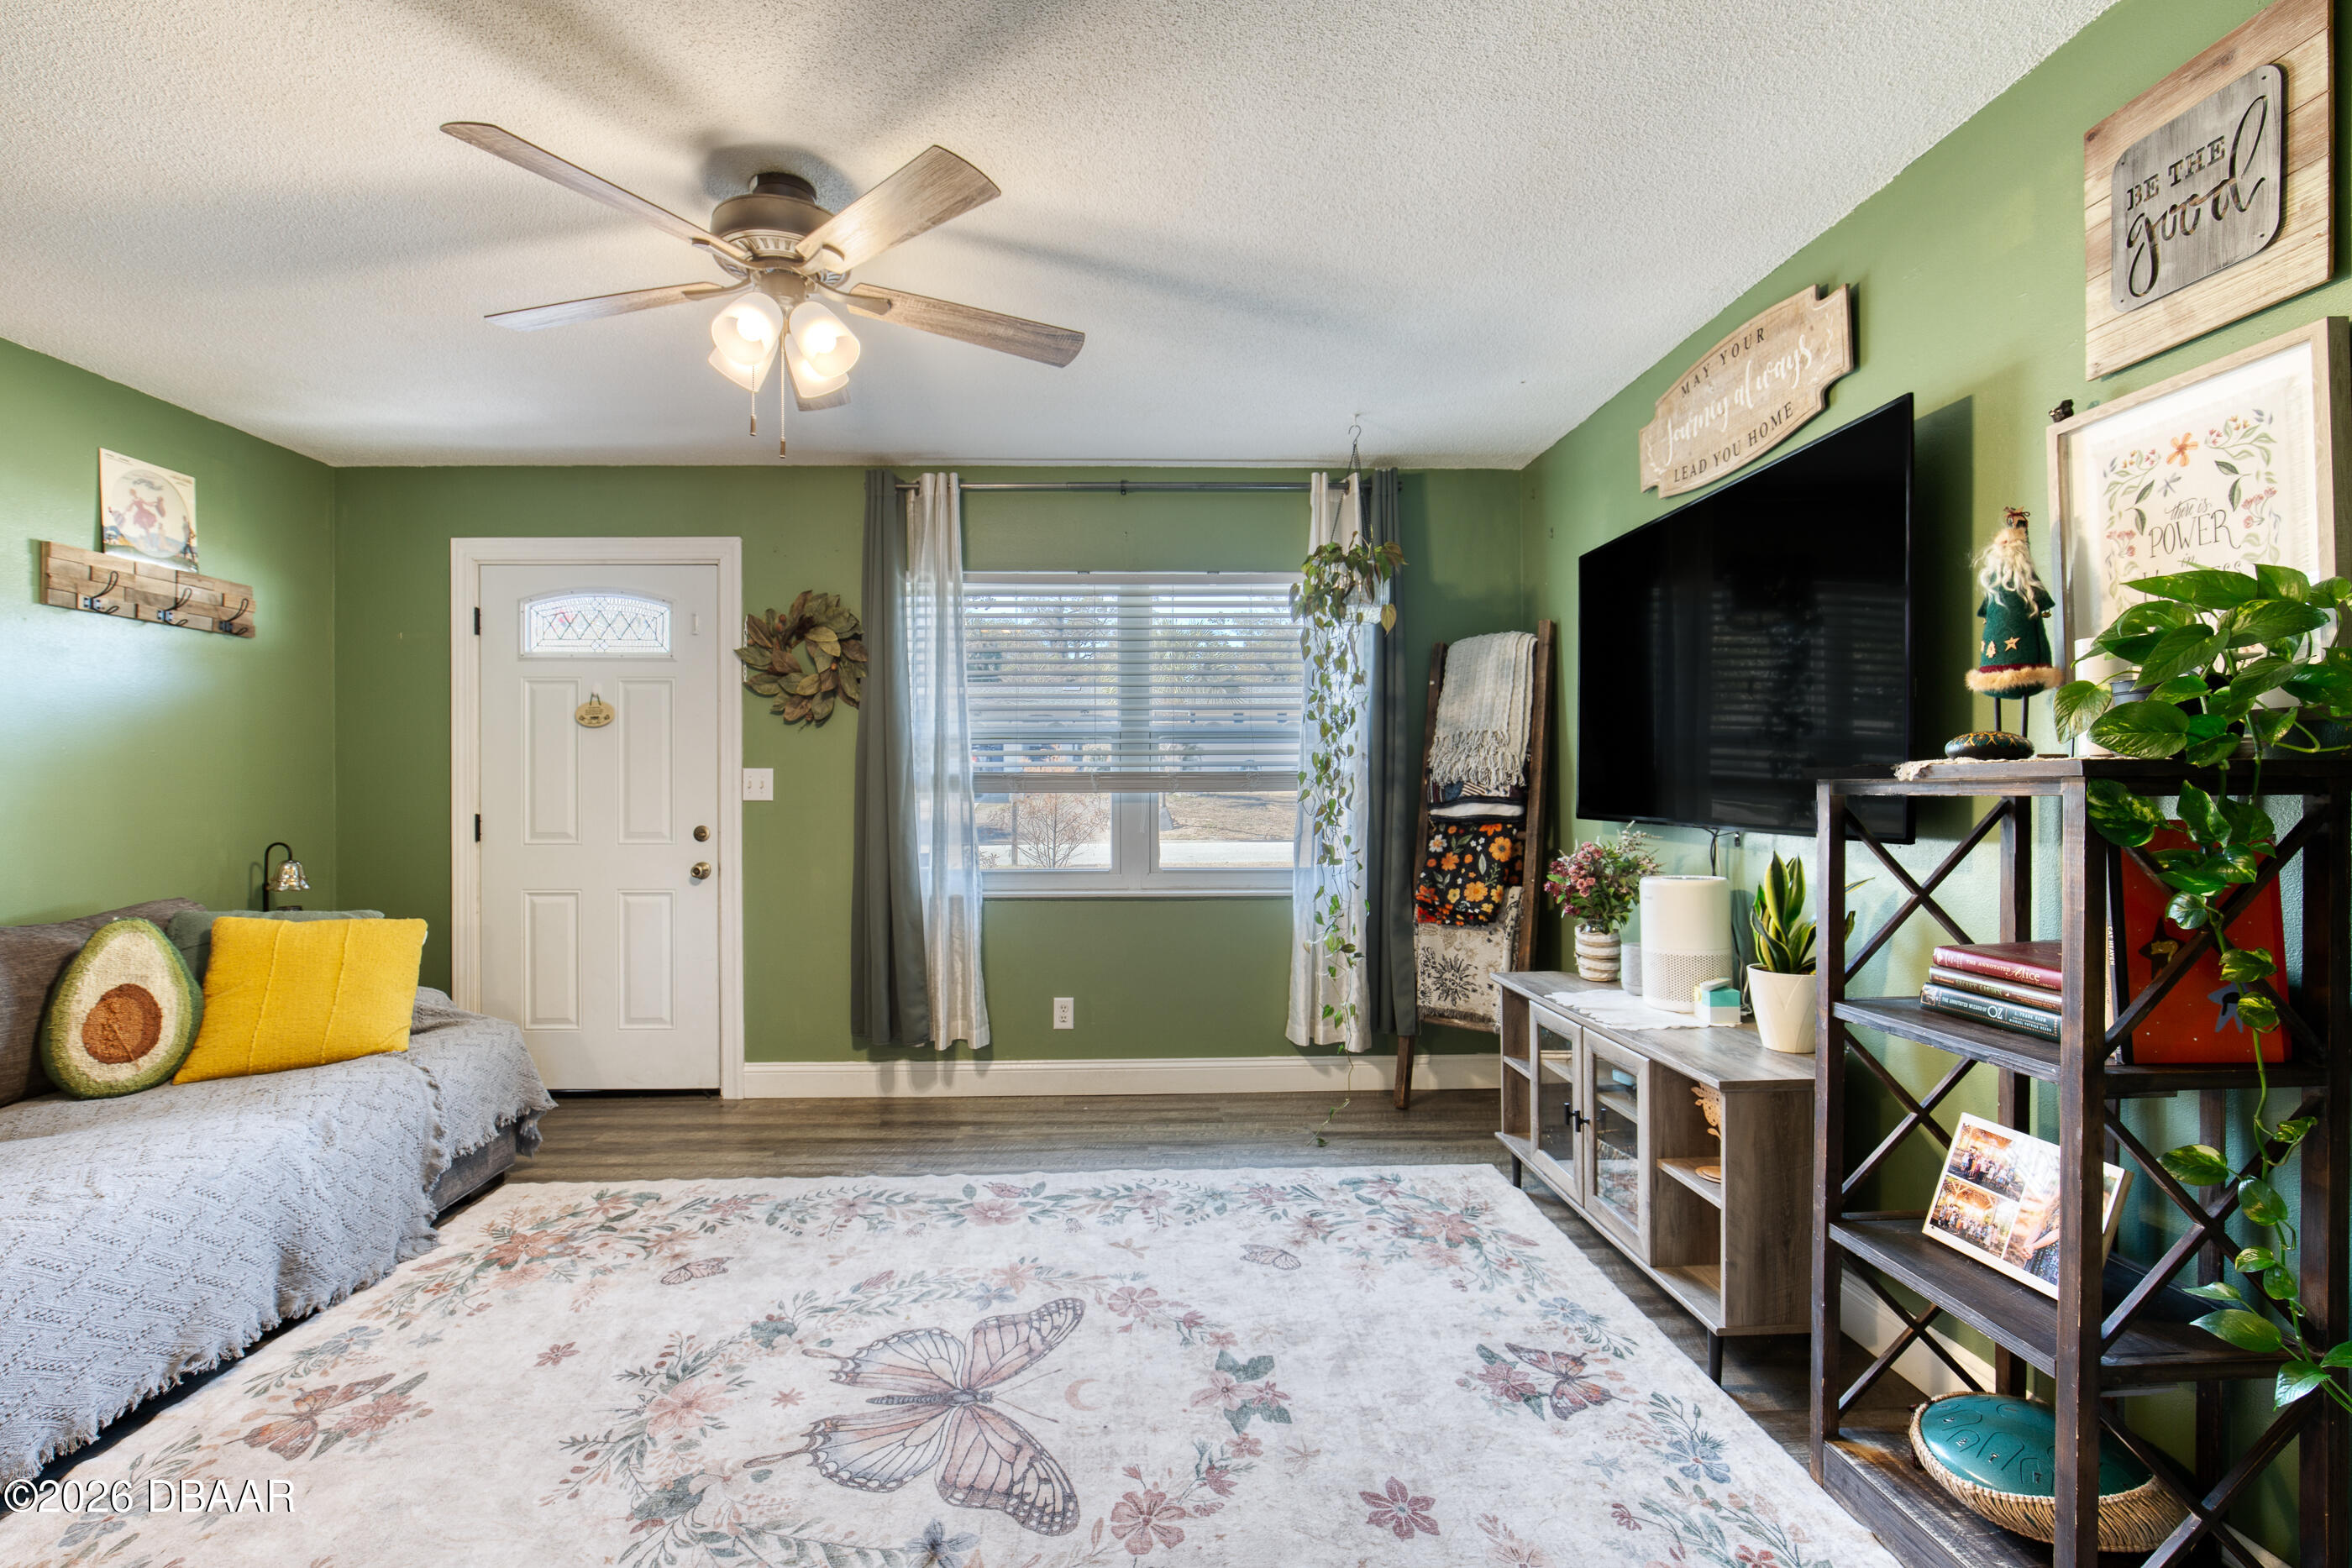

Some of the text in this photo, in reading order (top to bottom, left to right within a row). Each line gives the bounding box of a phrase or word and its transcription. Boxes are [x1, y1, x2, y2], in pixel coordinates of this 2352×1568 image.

[2126, 134, 2226, 211] BE THE
[2126, 94, 2267, 298] good
[1681, 328, 1766, 398] MAY YOUR
[1734, 334, 1813, 409] always
[1674, 401, 1795, 483] LEAD YOU HOME
[2149, 509, 2241, 559] POWER
[1977, 961, 2011, 973] ANNOTATED
[2005, 966, 2041, 982] Alice
[1979, 984, 2003, 997] GARDEN
[1987, 1005, 2003, 1020] OZ
